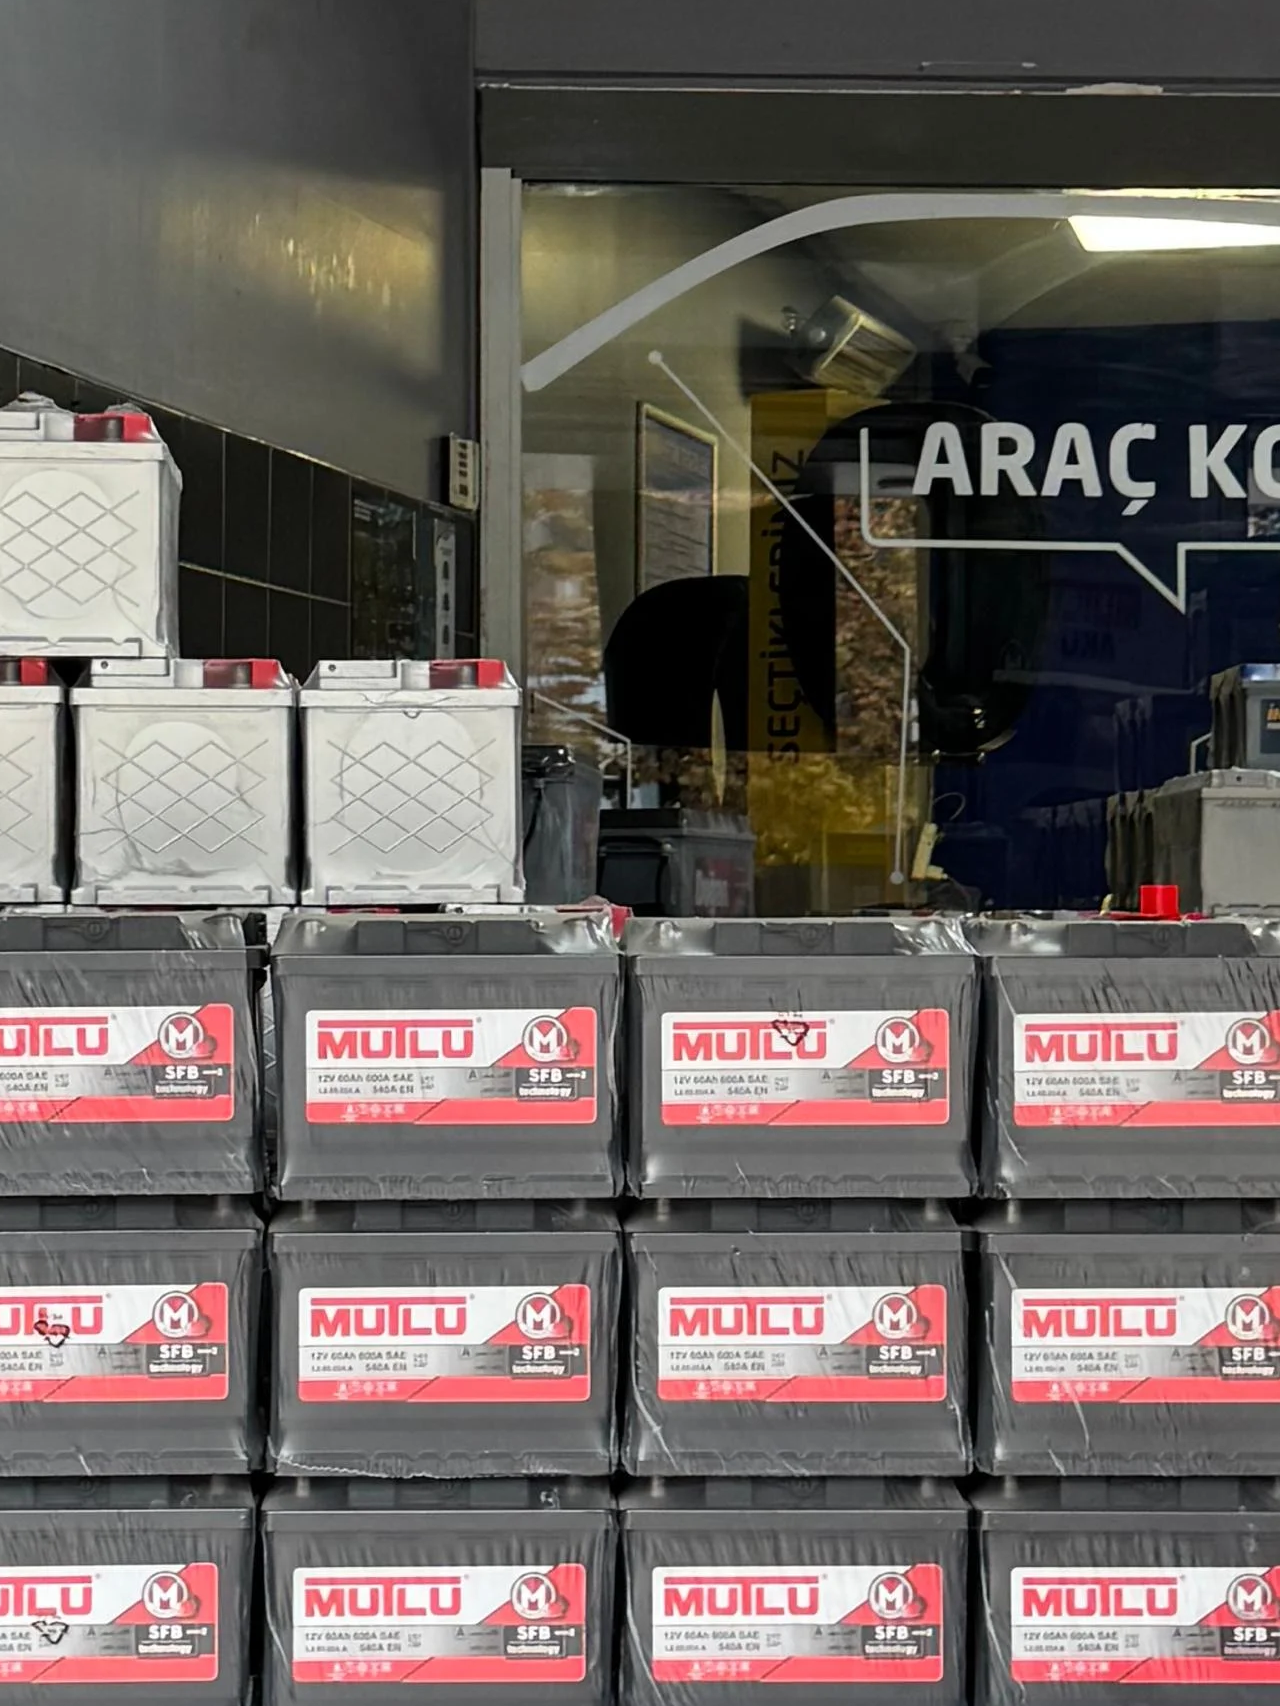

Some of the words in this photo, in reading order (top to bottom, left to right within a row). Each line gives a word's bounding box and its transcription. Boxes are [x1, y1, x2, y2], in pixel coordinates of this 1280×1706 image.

[912, 422, 1156, 516] ARAÇ
[318, 1019, 473, 1059] MUTLU
[673, 1020, 826, 1061] MUTLU
[1025, 1022, 1177, 1062] MUTLU
[164, 1066, 199, 1079] SFB
[528, 1068, 563, 1082] SFB
[881, 1070, 916, 1083] SFB
[1232, 1071, 1266, 1084] SFB
[311, 1297, 466, 1337] MUTLU
[670, 1296, 824, 1336] MUTLU
[1023, 1298, 1176, 1337] MUTLU
[159, 1345, 194, 1358] SFB
[522, 1346, 556, 1359] SFB
[879, 1346, 913, 1359] SFB
[1231, 1347, 1266, 1361] SFB
[305, 1577, 461, 1617] MUTLU
[664, 1576, 818, 1616] MUTLU
[1023, 1577, 1177, 1617] MUTLU
[148, 1625, 183, 1639] SFB
[516, 1626, 551, 1640] SFB
[874, 1626, 909, 1640] SFB
[1233, 1627, 1268, 1641] SFB
